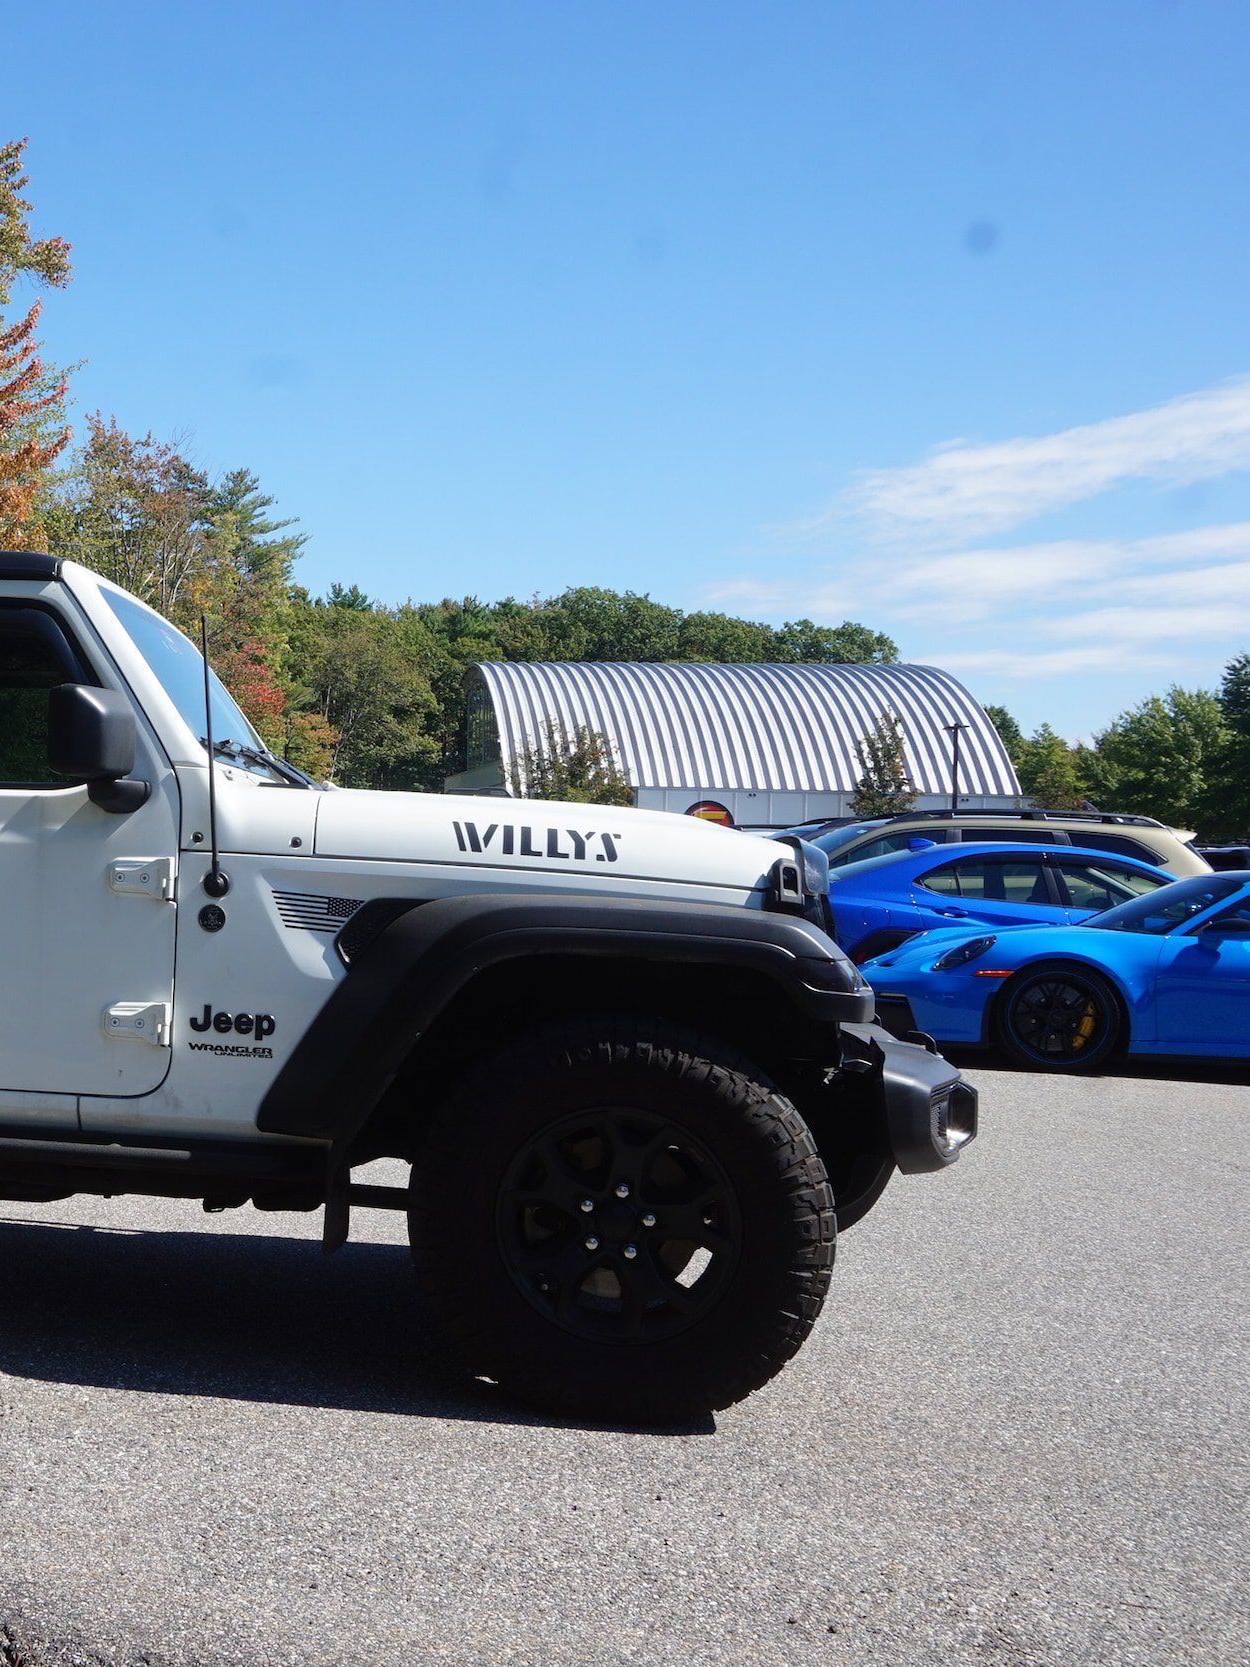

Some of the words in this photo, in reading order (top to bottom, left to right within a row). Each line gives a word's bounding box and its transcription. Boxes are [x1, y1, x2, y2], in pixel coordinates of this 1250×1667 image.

[452, 821, 622, 862] WILLYS
[189, 1003, 276, 1041] Jeep
[188, 1042, 273, 1055] WRANGLER
[214, 1051, 273, 1059] UNLIMITED
